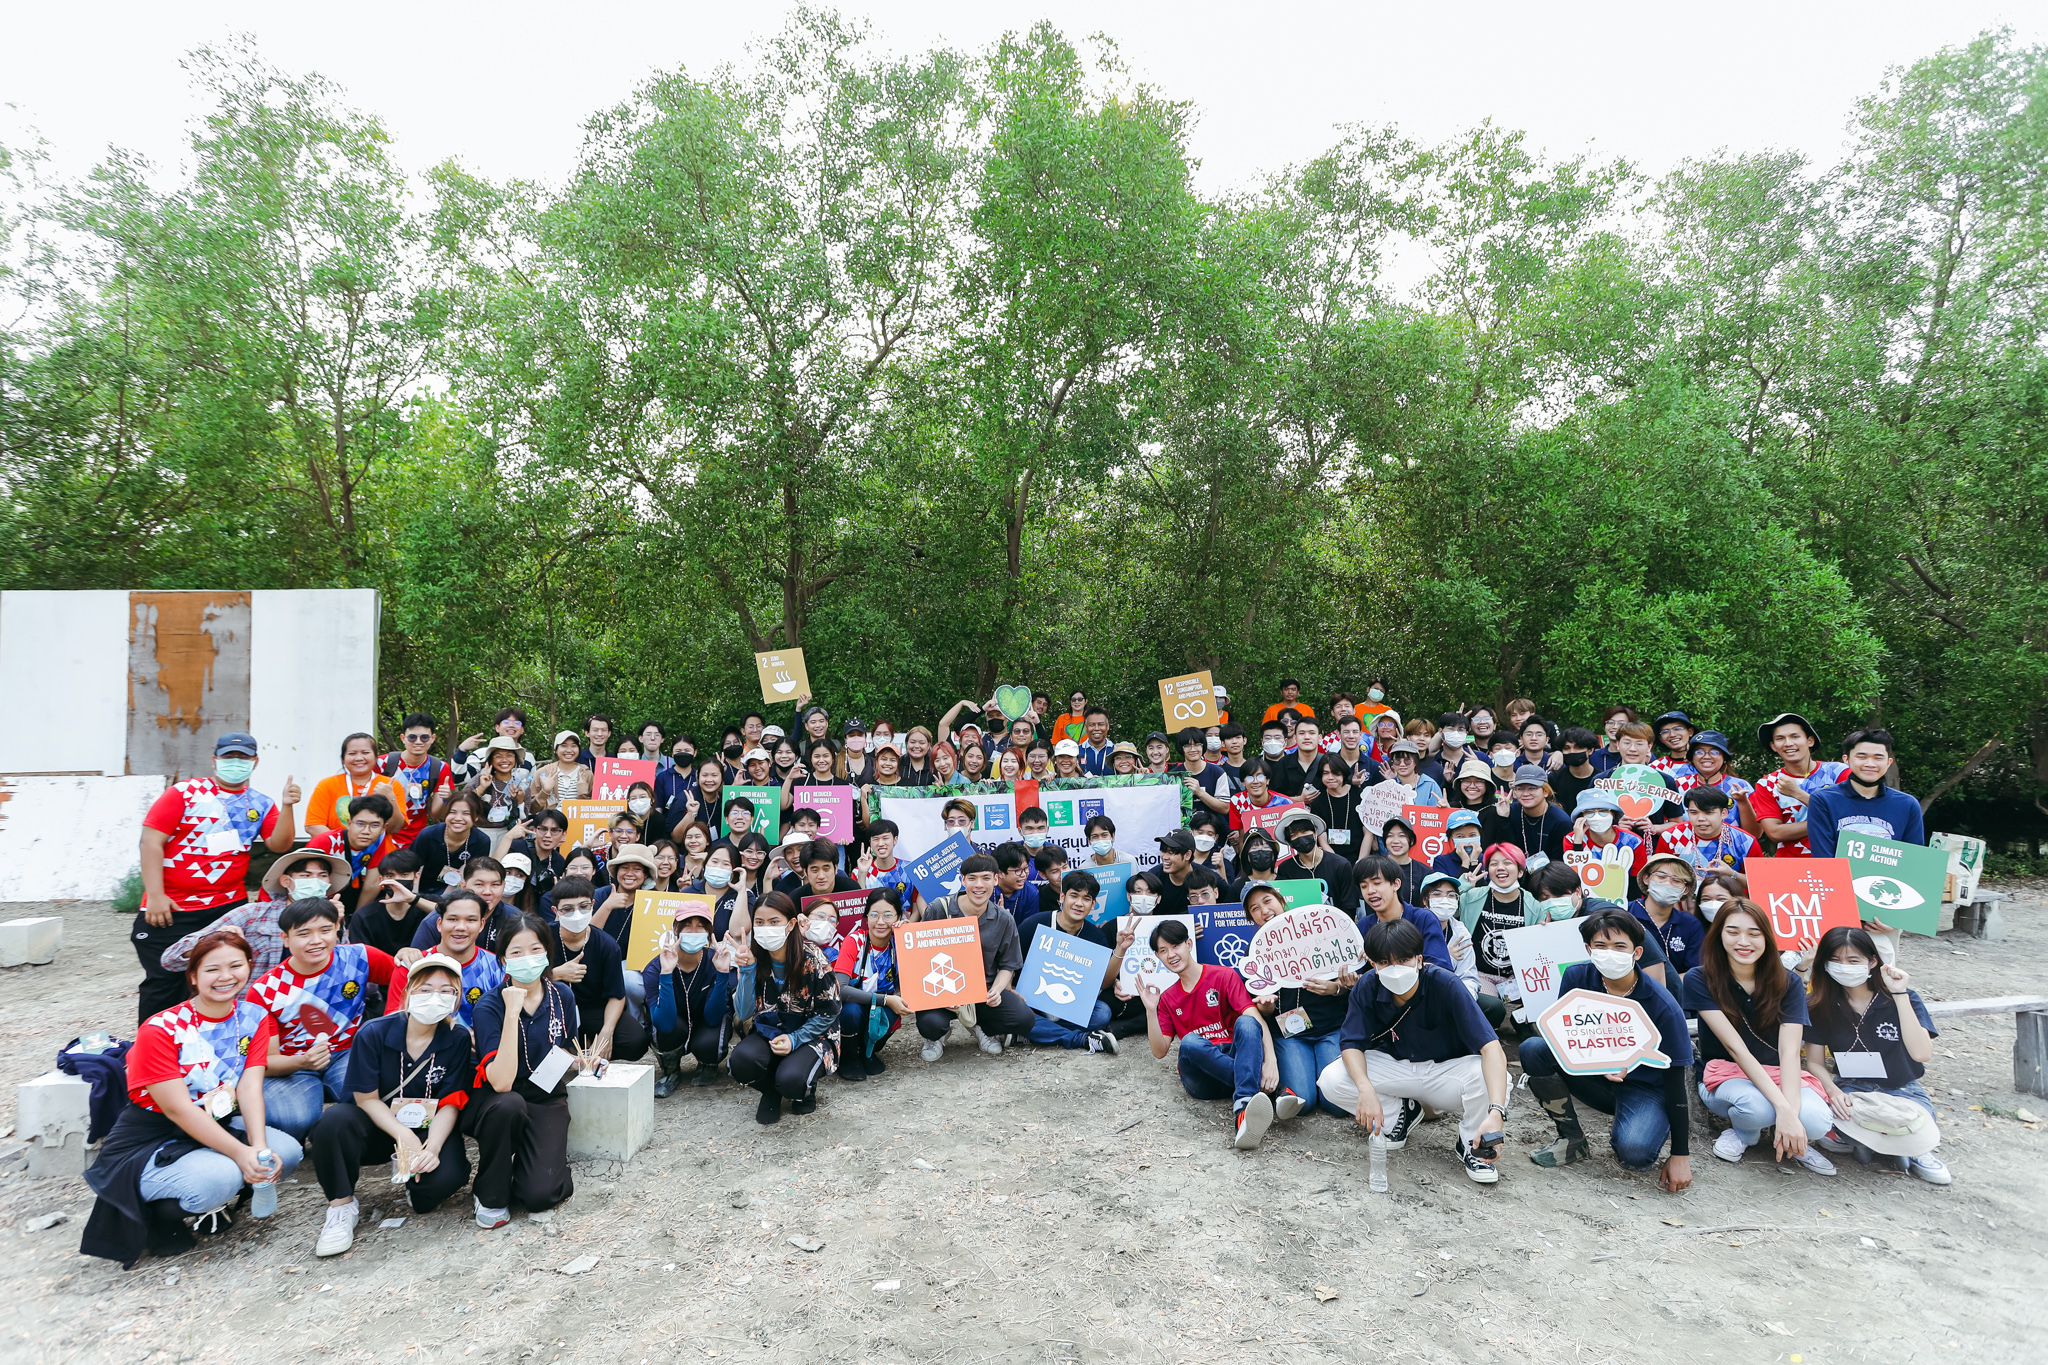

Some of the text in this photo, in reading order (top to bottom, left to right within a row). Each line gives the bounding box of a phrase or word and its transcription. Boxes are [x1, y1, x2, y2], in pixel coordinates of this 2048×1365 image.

[762, 657, 768, 668] 2
[1164, 683, 1175, 695] 12
[602, 762, 607, 774] 1
[799, 791, 810, 804] 10
[1595, 779, 1683, 804] SAVE the EARTH
[567, 806, 578, 819] 11
[1261, 812, 1279, 821] QUALITY
[1409, 811, 1416, 825] 5
[1421, 812, 1439, 820] GENDER
[1250, 816, 1257, 827] 4
[1420, 820, 1442, 828] EQUALITY
[925, 841, 959, 866] PEACE, JUSTICE
[1846, 840, 1865, 859] 13
[1871, 844, 1903, 858] CLIMATE
[930, 852, 957, 872] AND STRONG
[1566, 853, 1589, 864] Say
[1869, 854, 1898, 867] ACTION
[913, 864, 929, 880] 16
[934, 857, 963, 879] INSTITUTIONS
[643, 898, 653, 914] 7
[846, 897, 862, 906] WORK
[1768, 893, 1822, 915] KM
[657, 908, 675, 916] CLEAN
[839, 906, 866, 917] OMIC GRO
[1197, 912, 1209, 928] 17
[1226, 919, 1236, 927] THE
[916, 925, 975, 938] INDUSTRY, INNOVATION
[1264, 911, 1336, 946] เขาไม่รัก
[904, 932, 914, 950] 9
[917, 934, 975, 949] AND INFRASTRUCTURE
[1038, 934, 1054, 952] 14
[1058, 940, 1070, 949] LIFE
[1055, 948, 1093, 968] BELOW WATER
[1274, 939, 1359, 980] ปลูกต้นไม้
[1125, 957, 1171, 974] GOA
[1521, 966, 1549, 980] KM
[1574, 1013, 1603, 1026] SAY
[1606, 1012, 1631, 1024] NO
[1580, 1027, 1613, 1035] SINGLE
[1616, 1026, 1634, 1034] USE
[1568, 1036, 1636, 1049] PLASTICS
